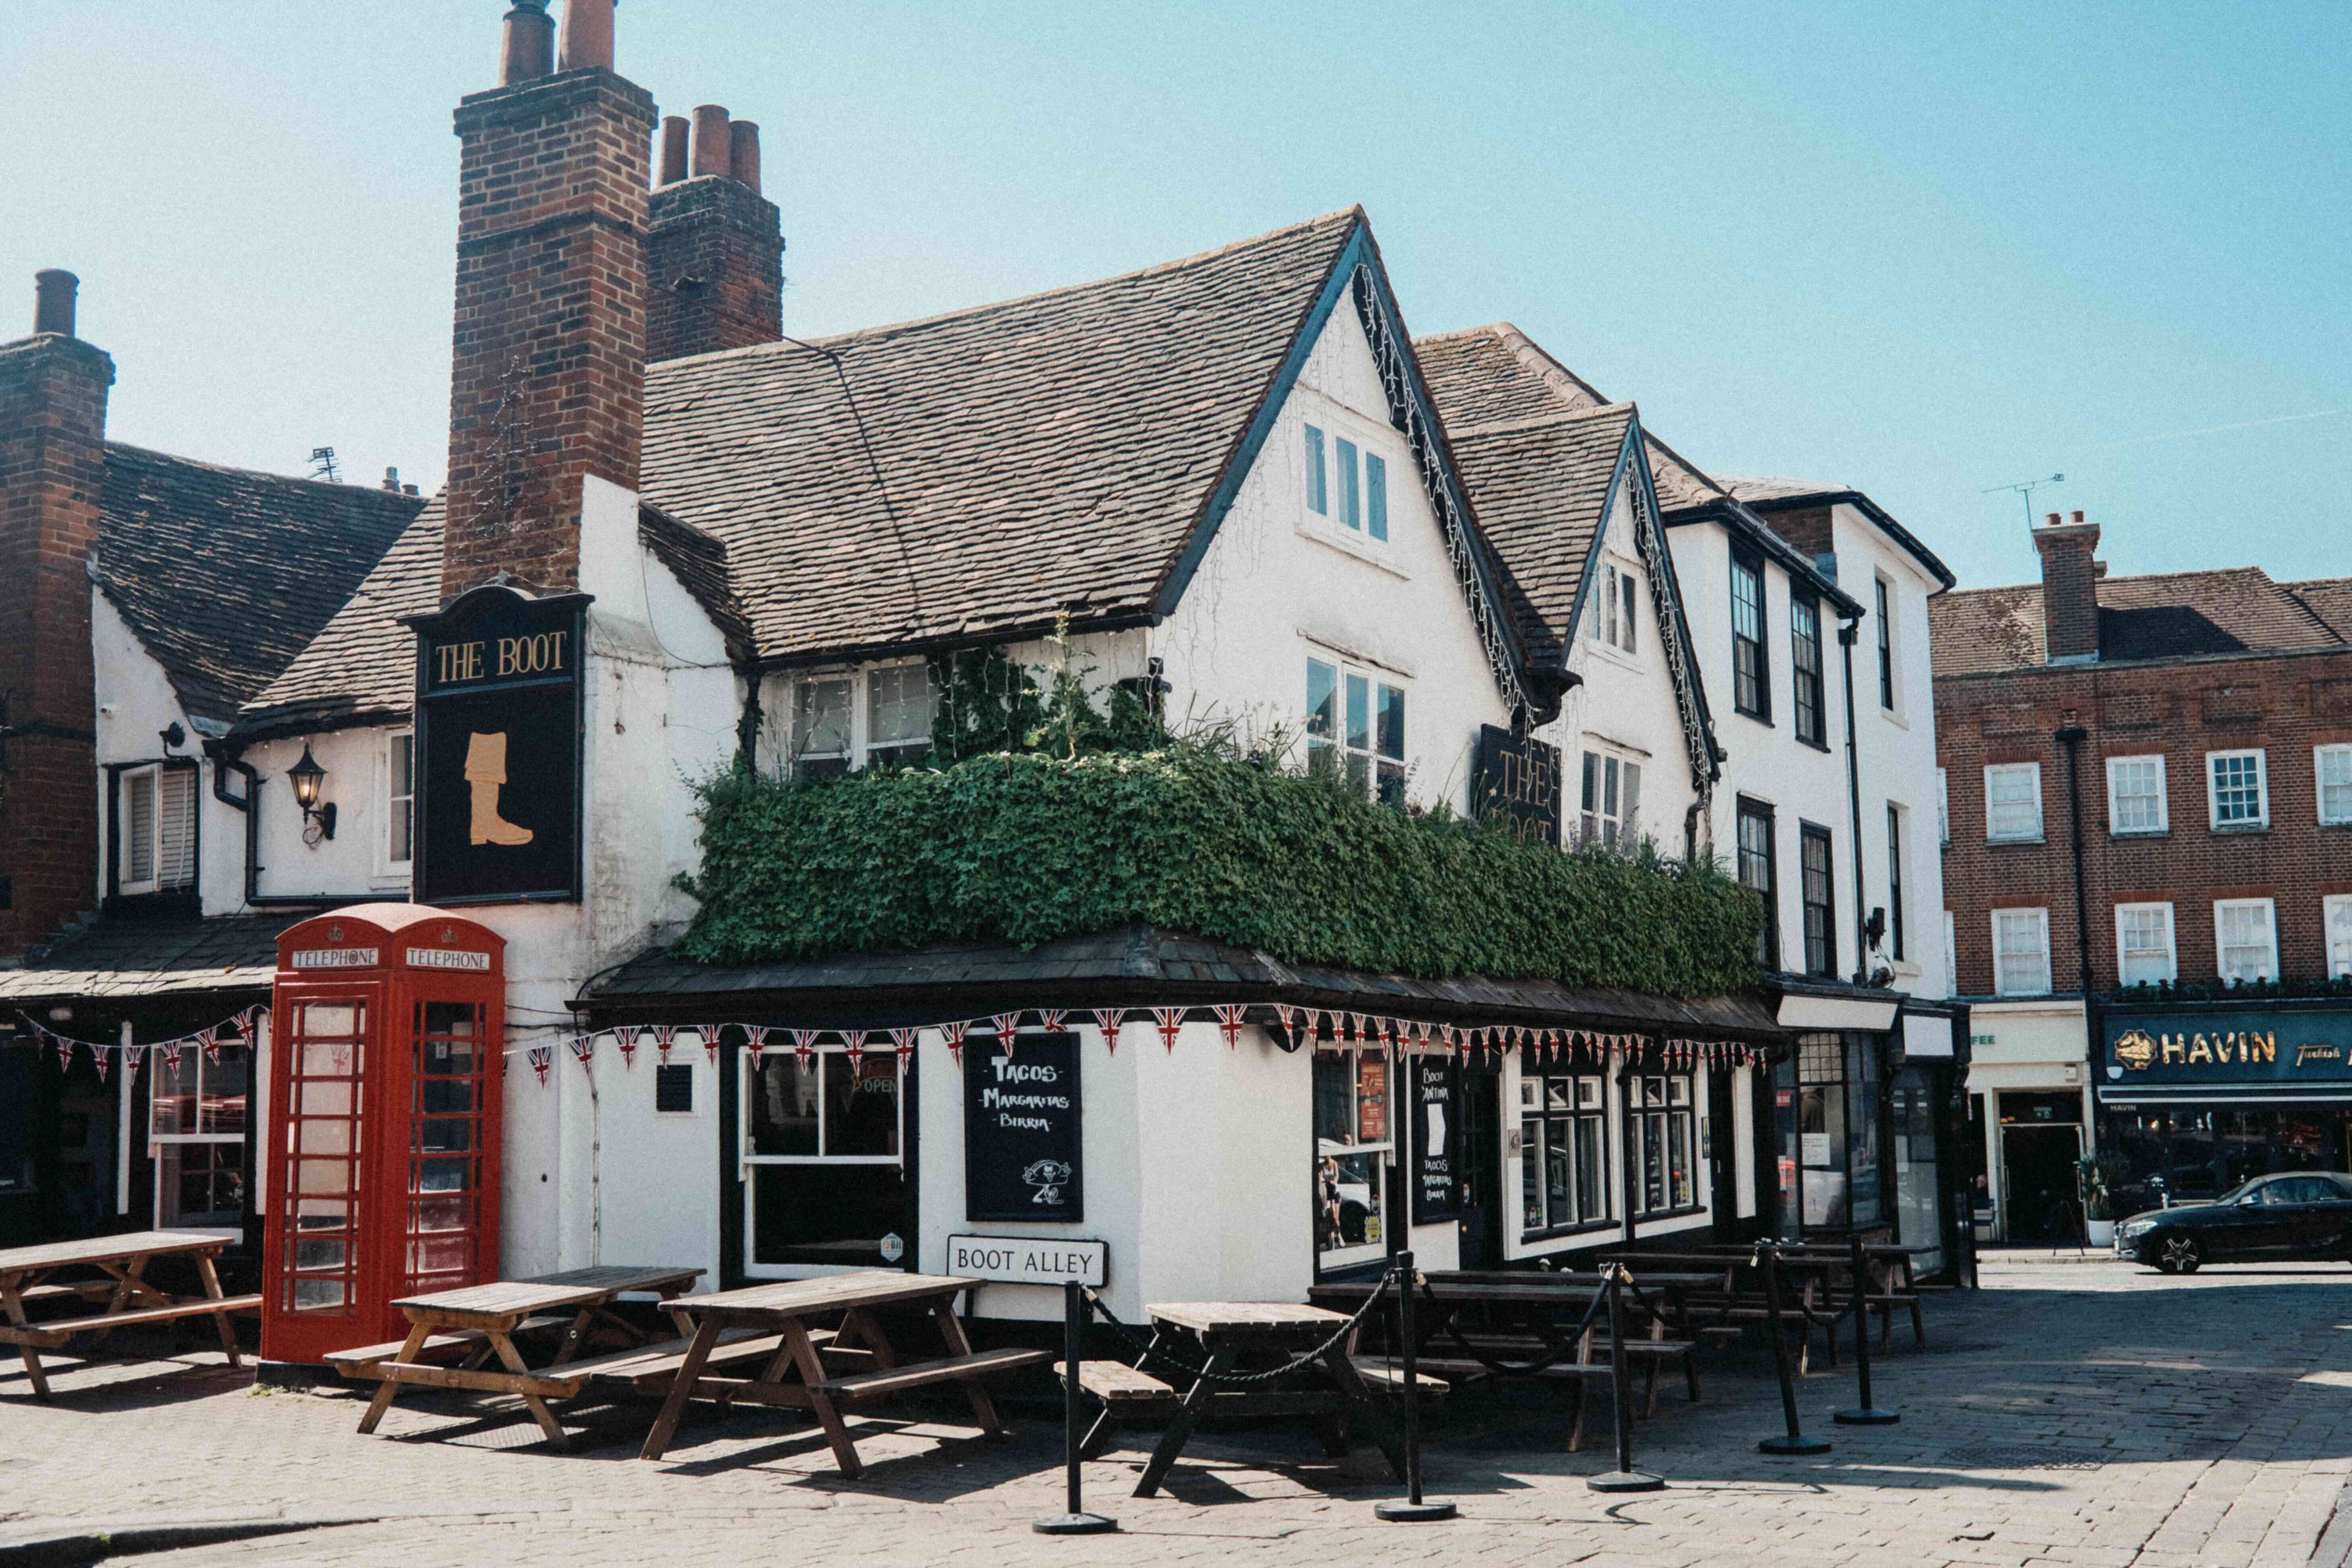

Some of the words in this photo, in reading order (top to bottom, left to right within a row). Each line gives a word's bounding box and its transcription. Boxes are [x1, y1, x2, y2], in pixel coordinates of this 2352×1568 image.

[436, 641, 485, 682] THE
[497, 631, 567, 676] BOOT
[1500, 750, 1547, 807] THE
[296, 949, 377, 966] TELEPHONE
[409, 950, 489, 969] TELEPHONE
[2161, 1031, 2275, 1064] HAVIN
[2296, 1044, 2341, 1067] Turkish
[864, 1078, 897, 1093] OPEN
[958, 1249, 1015, 1270] BOOT
[1025, 1251, 1092, 1274] ALLEY
